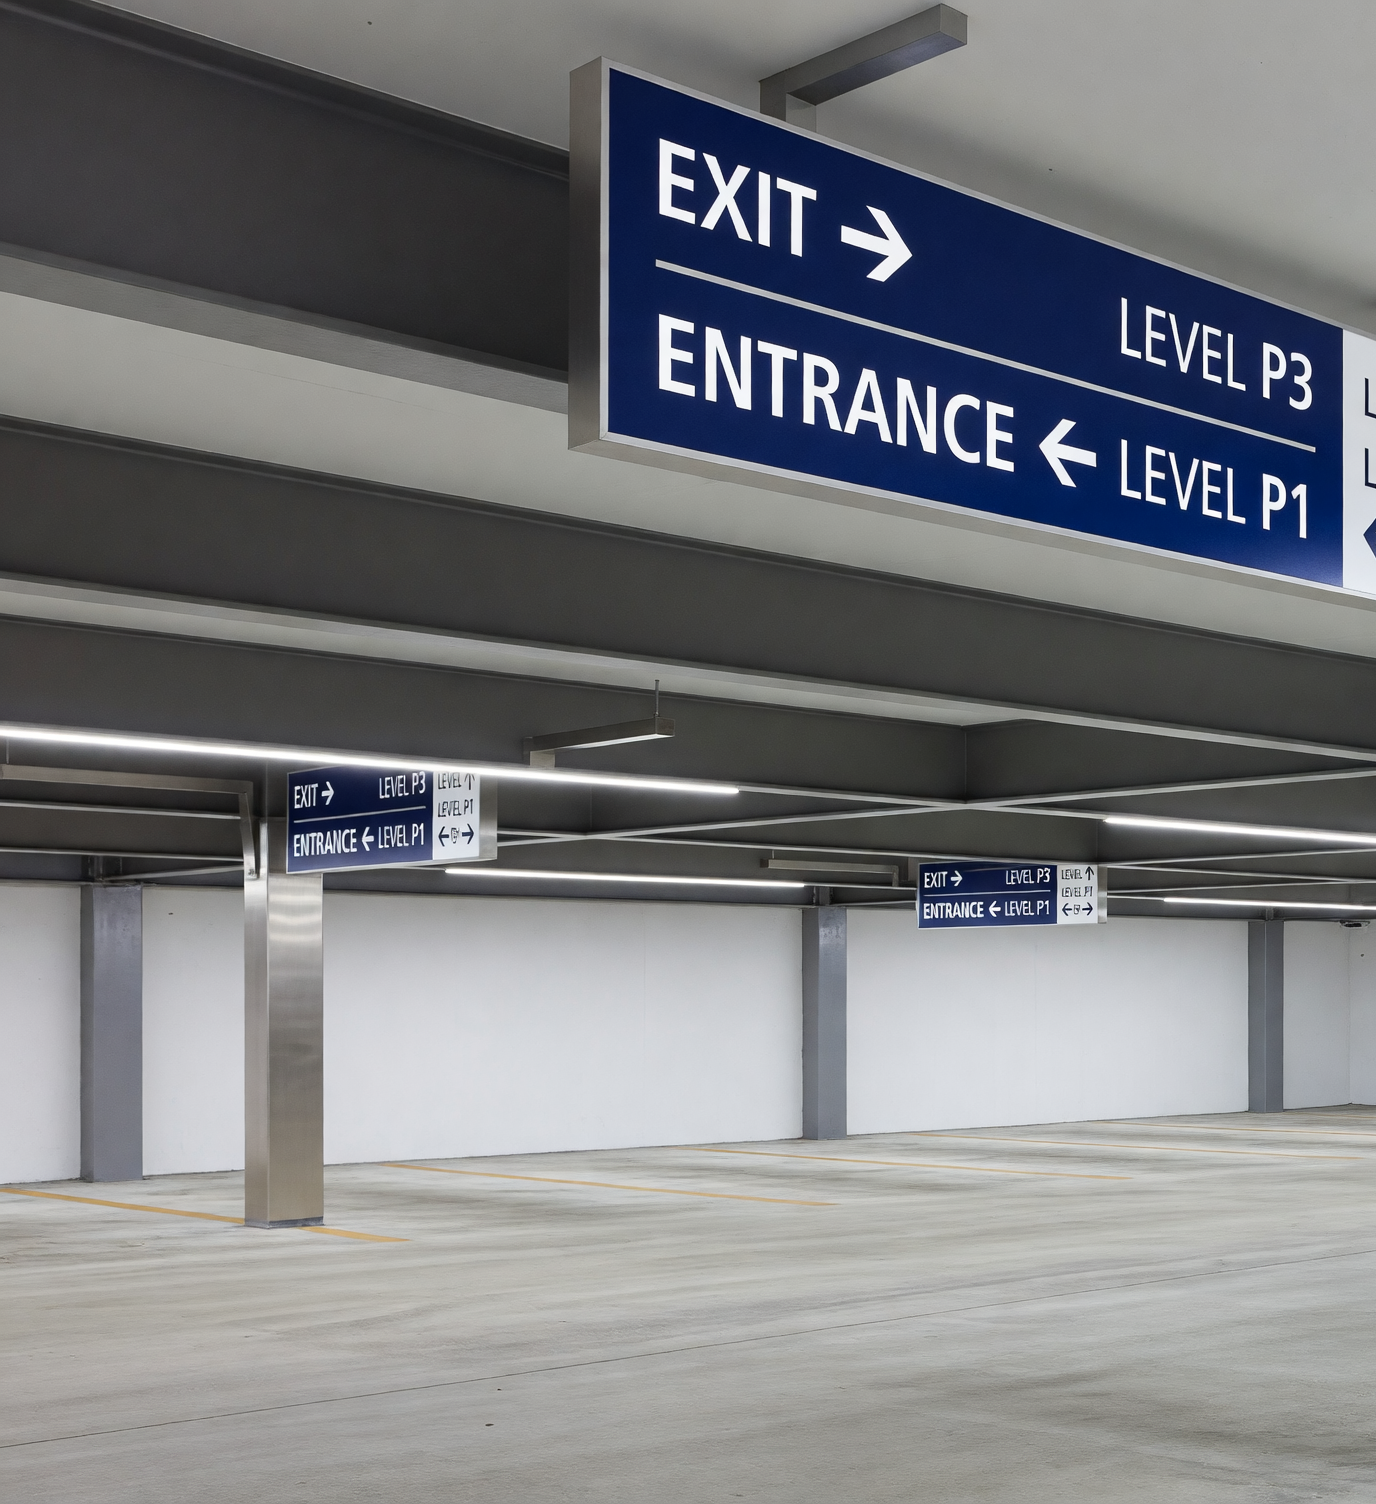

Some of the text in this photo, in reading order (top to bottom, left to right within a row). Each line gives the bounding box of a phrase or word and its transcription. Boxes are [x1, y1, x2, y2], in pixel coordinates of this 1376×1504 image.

[658, 138, 817, 258] EXIT
[1120, 297, 1313, 411] LEVEL P3
[657, 314, 1308, 539] ENTRANCE LEVEL P1
[294, 783, 318, 809] EXIT
[379, 771, 426, 799] LEVEL P3
[438, 798, 474, 818] LEVEL P1
[293, 822, 425, 857] ENTRANCE LEVEL P1
[924, 871, 948, 888] EXIT
[1005, 868, 1051, 885] LEVEL P3
[923, 900, 1050, 919] ENTRANCE LEVEL P1
